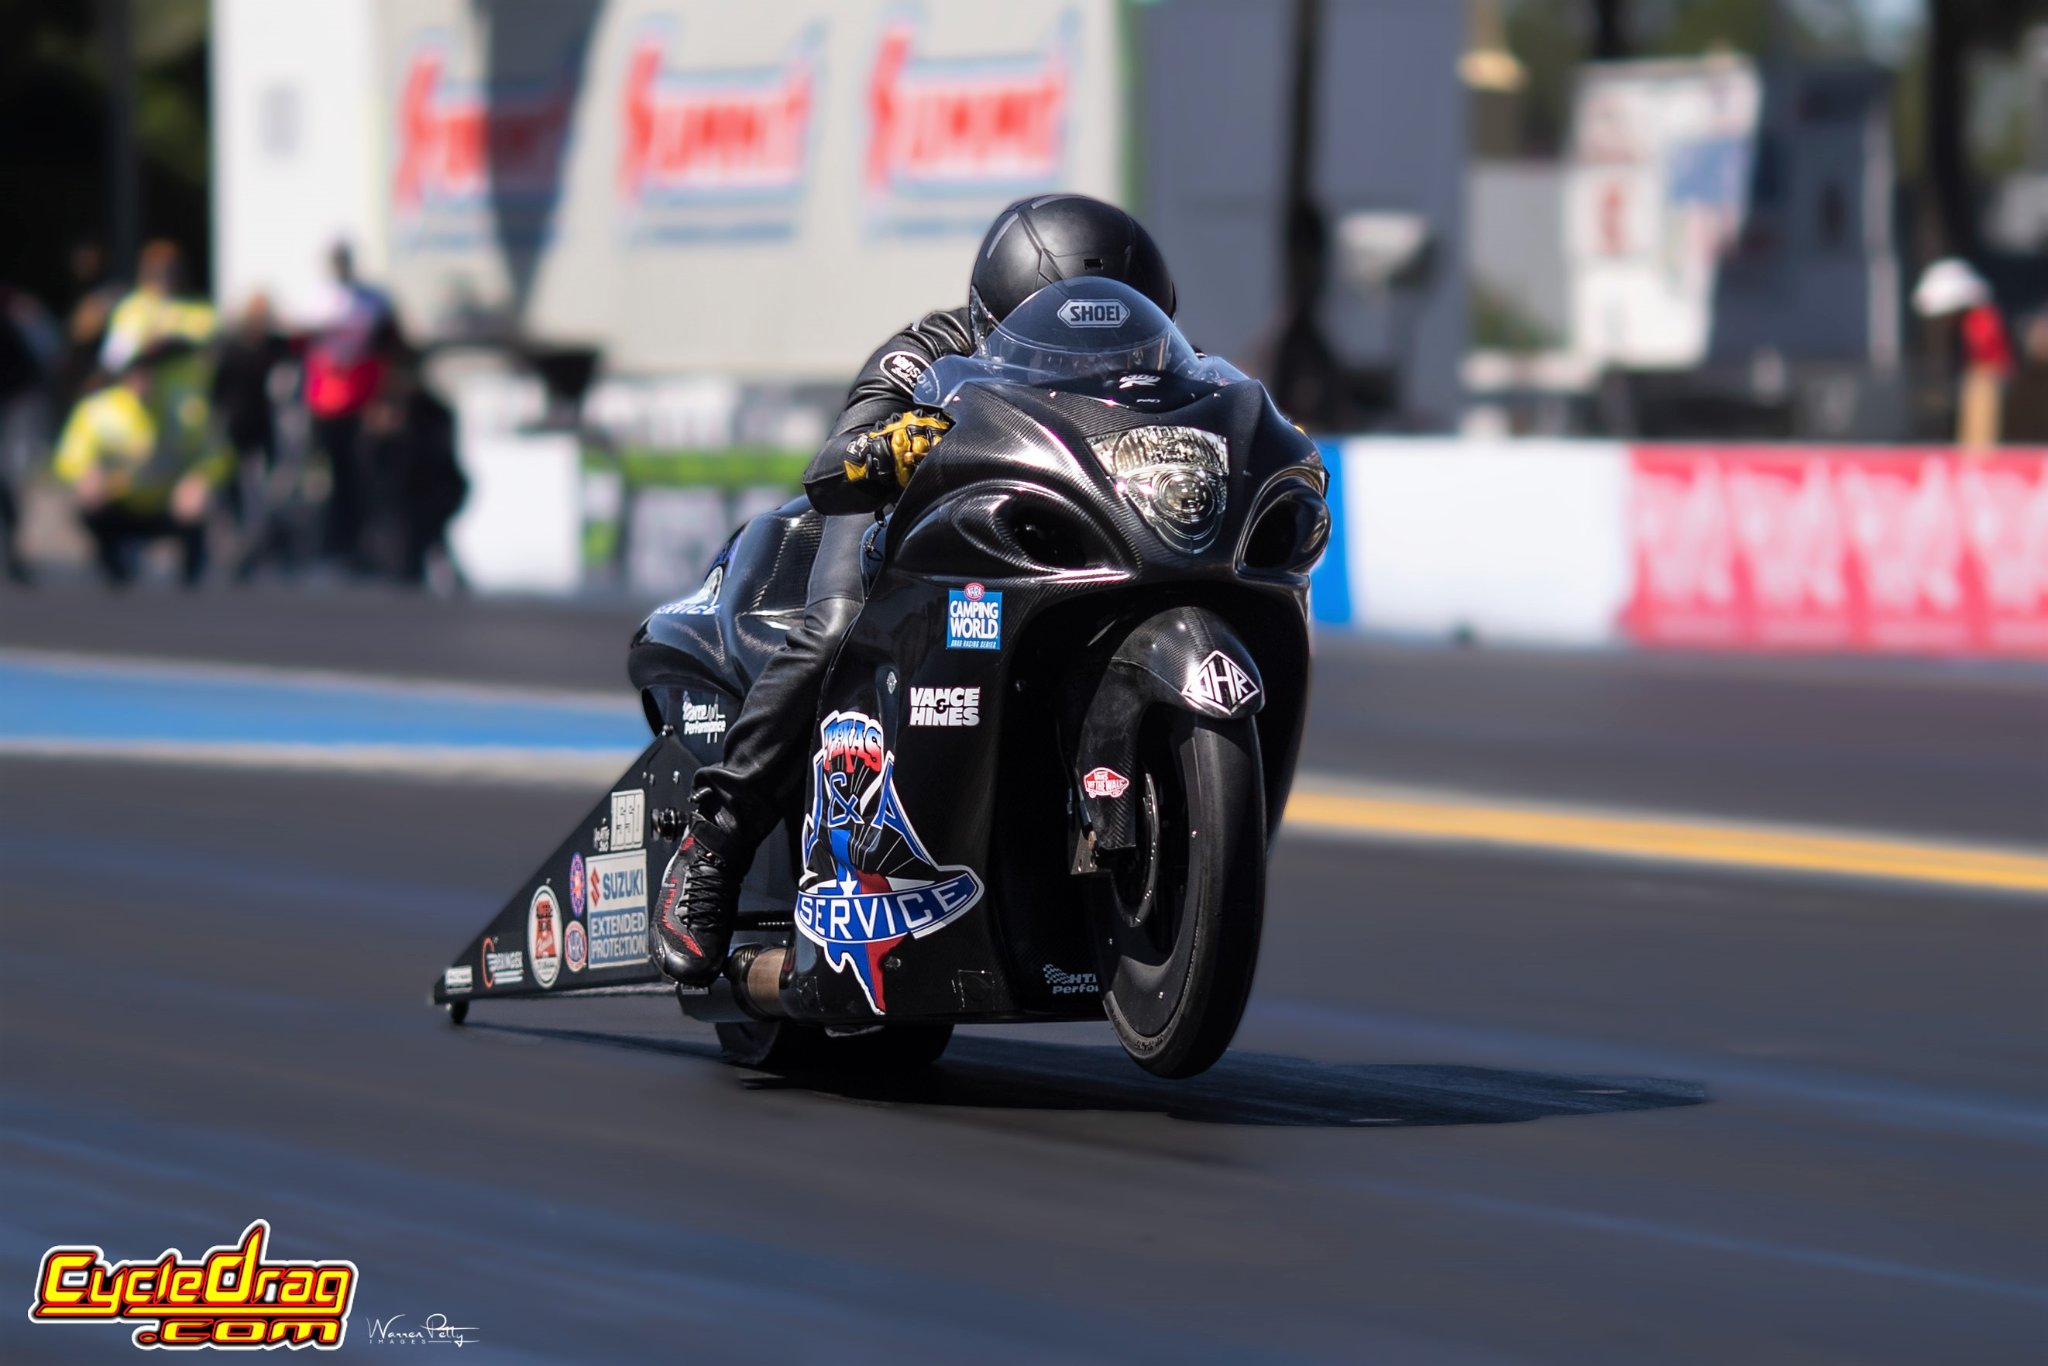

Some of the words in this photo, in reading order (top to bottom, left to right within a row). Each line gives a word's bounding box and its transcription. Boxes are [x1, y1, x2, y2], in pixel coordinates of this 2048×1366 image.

[1070, 305, 1120, 322] SHOEI
[950, 600, 999, 619] CAMPING
[950, 618, 998, 639] WORLD
[910, 687, 980, 707] VANCE
[910, 707, 980, 726] HINES
[824, 719, 882, 773] TEXAS
[828, 772, 864, 827] &
[871, 758, 931, 865] A
[603, 868, 644, 900] SUZUKI
[800, 882, 968, 939] SERVICE
[591, 912, 646, 937] EXTENDED
[591, 934, 647, 959] PROTECTION
